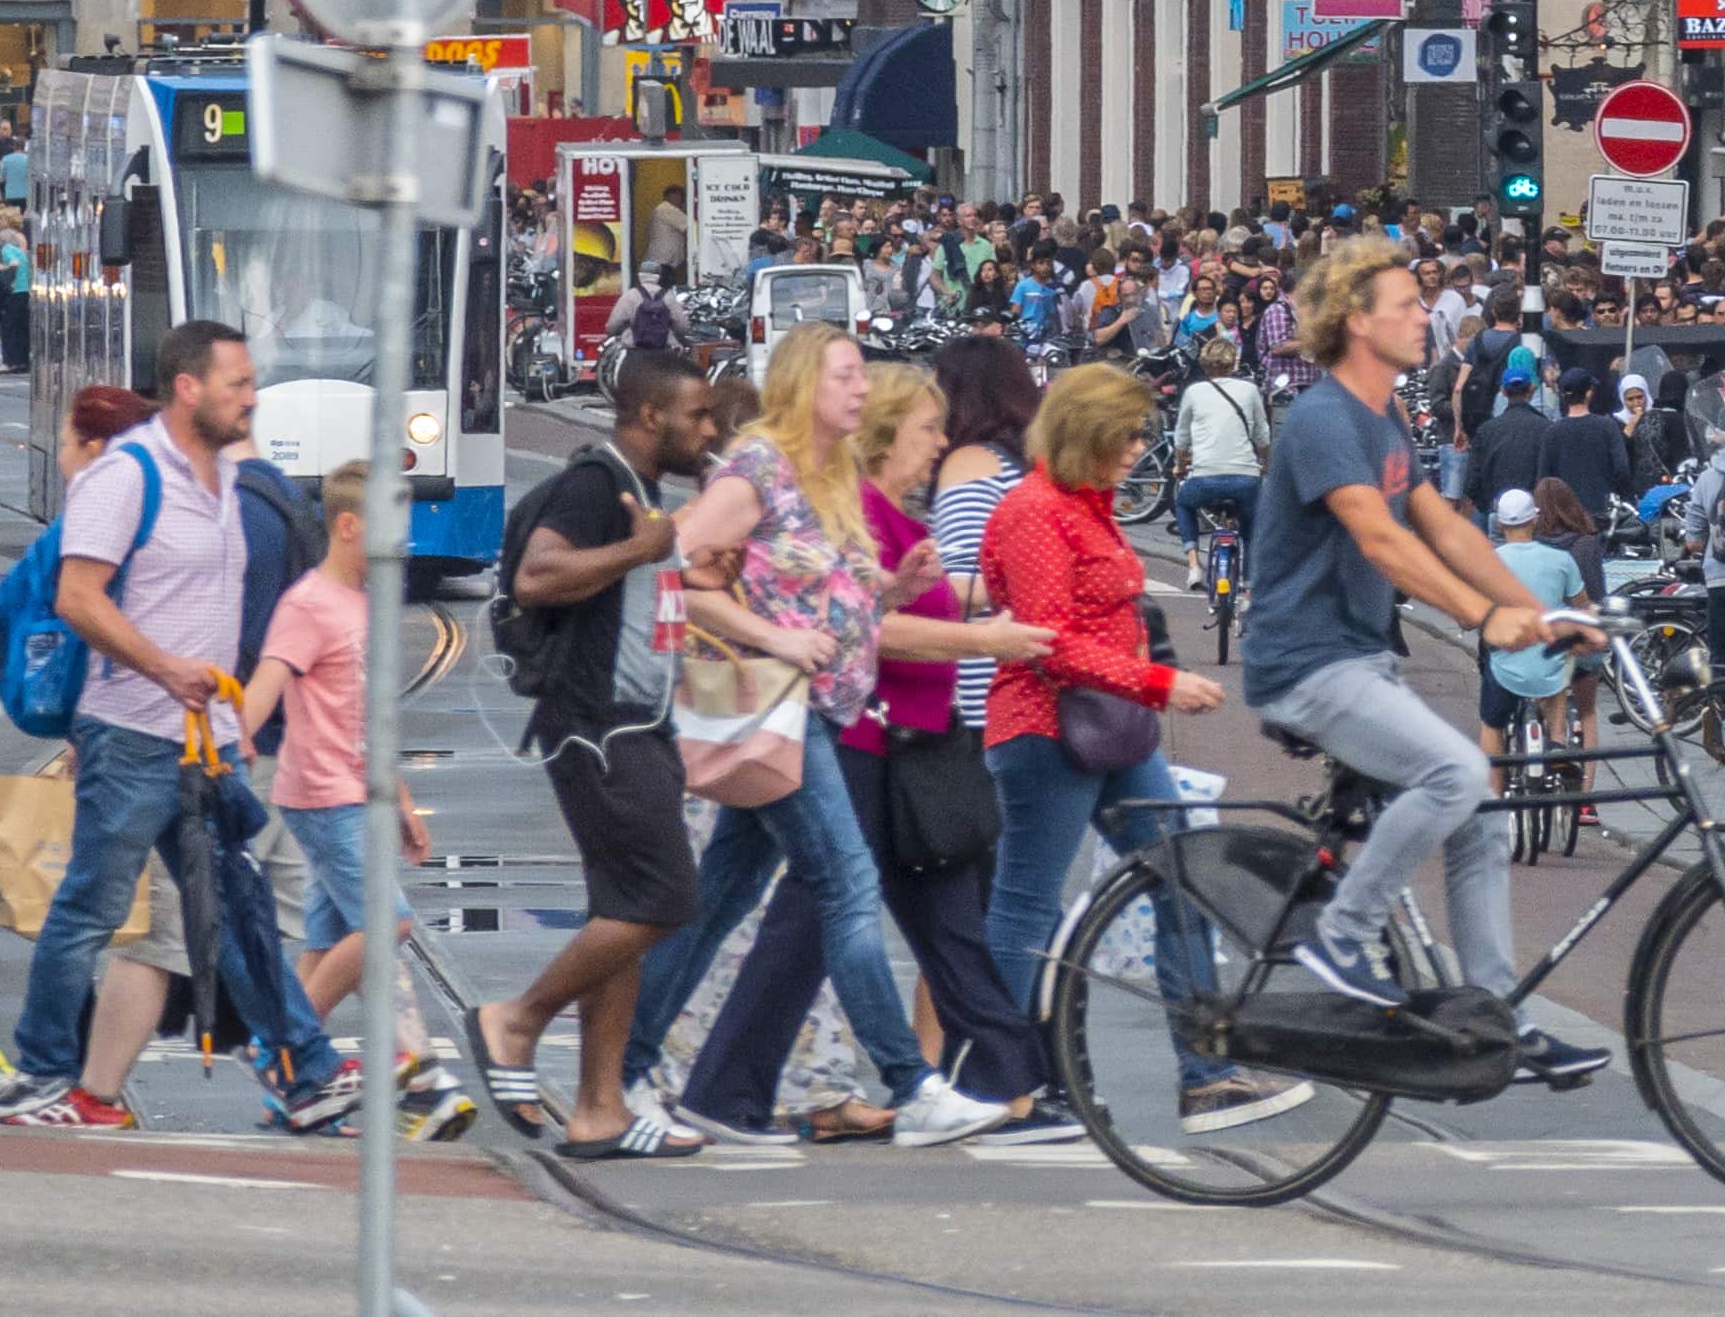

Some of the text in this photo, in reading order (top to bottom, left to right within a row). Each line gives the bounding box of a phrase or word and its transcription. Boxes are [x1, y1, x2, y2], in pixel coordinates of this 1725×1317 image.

[737, 18, 776, 55] WAAL
[202, 102, 224, 143] 9
[1645, 200, 1679, 210] lossen
